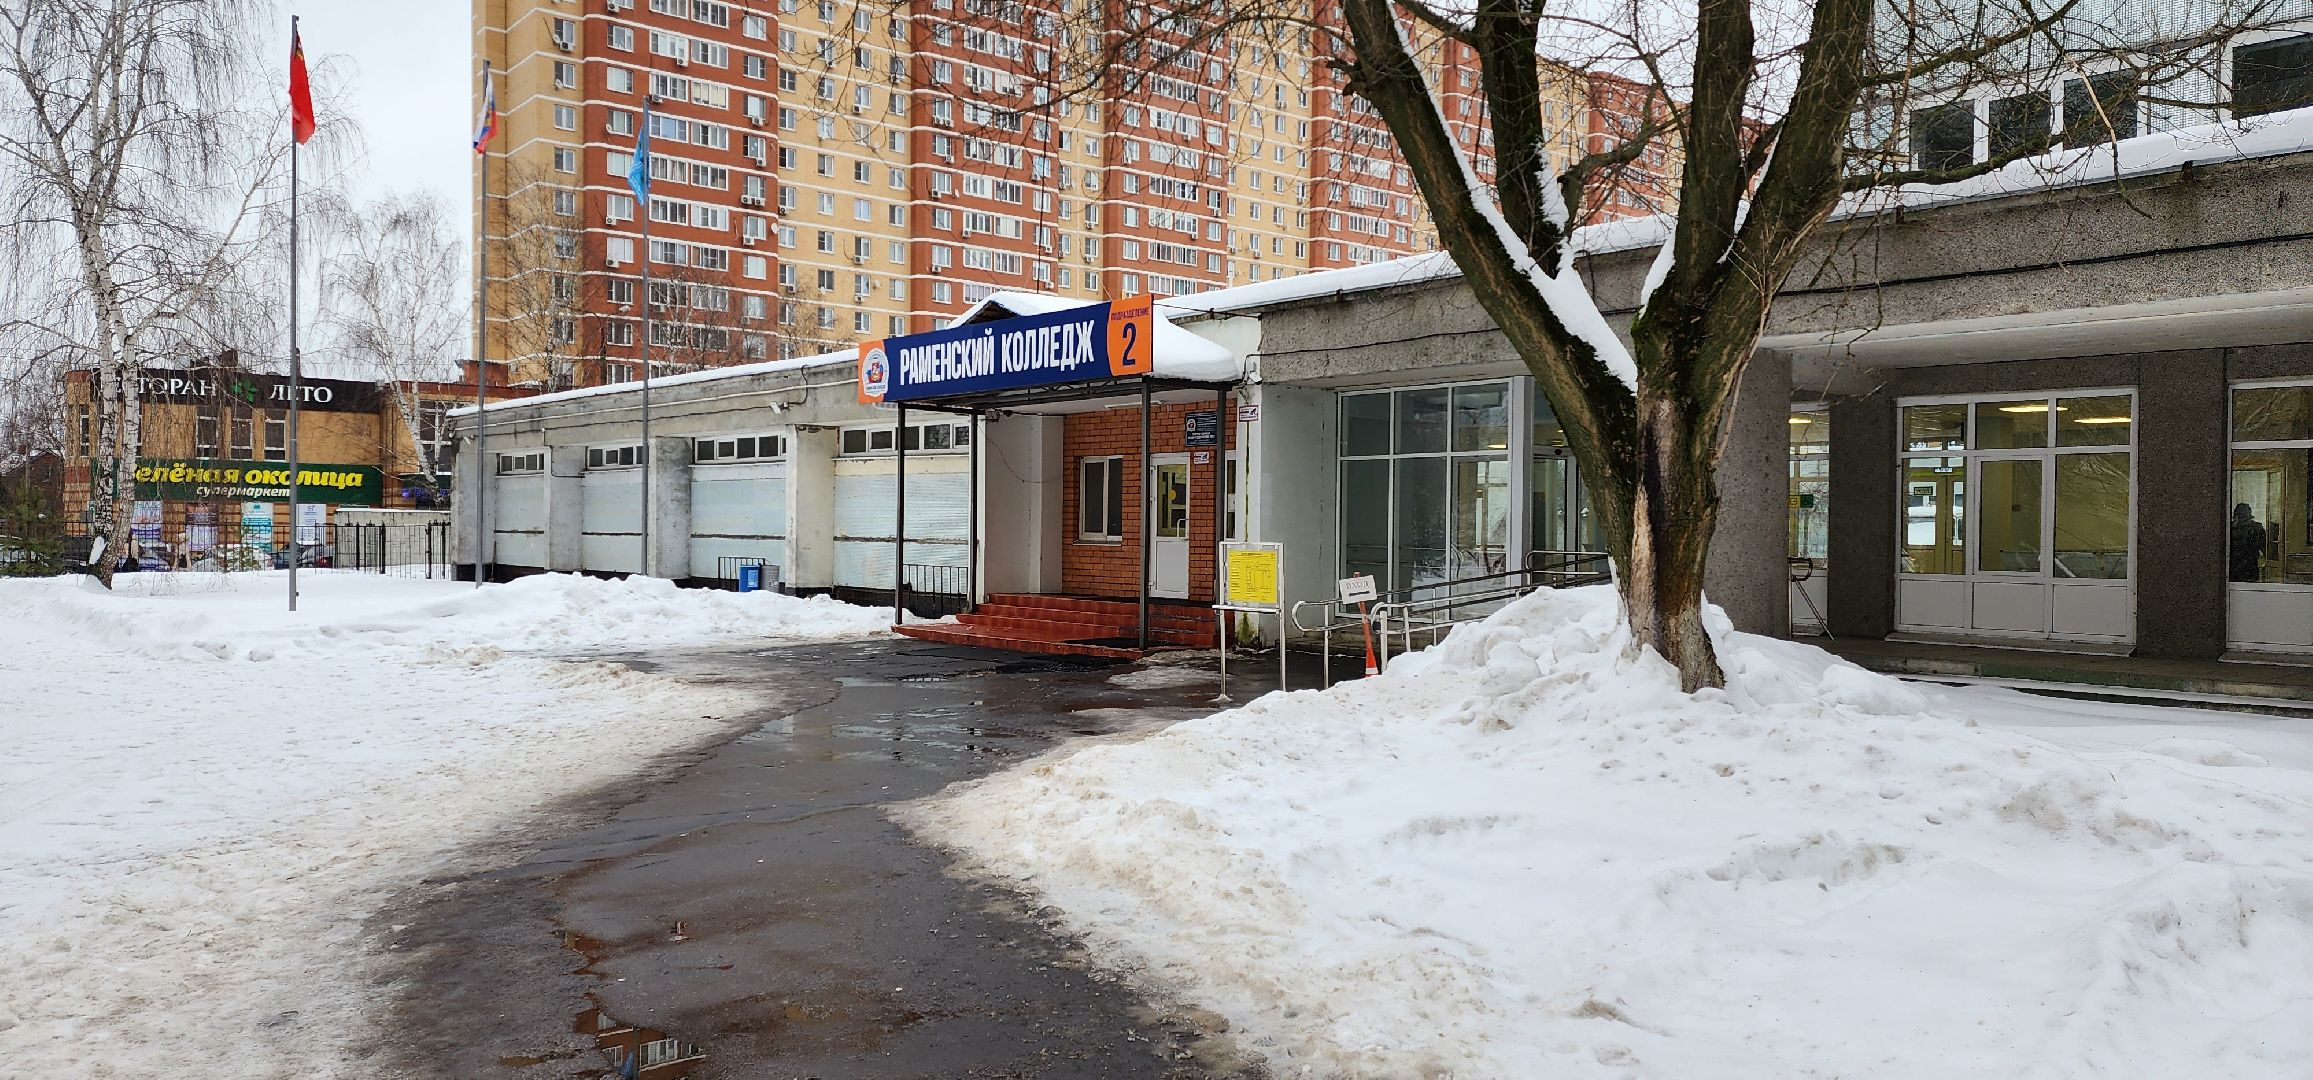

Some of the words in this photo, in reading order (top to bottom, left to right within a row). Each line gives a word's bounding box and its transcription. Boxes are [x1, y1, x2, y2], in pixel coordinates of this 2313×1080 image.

[899, 327, 995, 386] РАМЕНСКИЙ
[1001, 319, 1095, 372] КОЛЛЕДЖ
[1122, 322, 1137, 366] 2
[134, 462, 240, 483] елёная
[244, 468, 363, 490] околица
[196, 485, 290, 498] супермаркет
